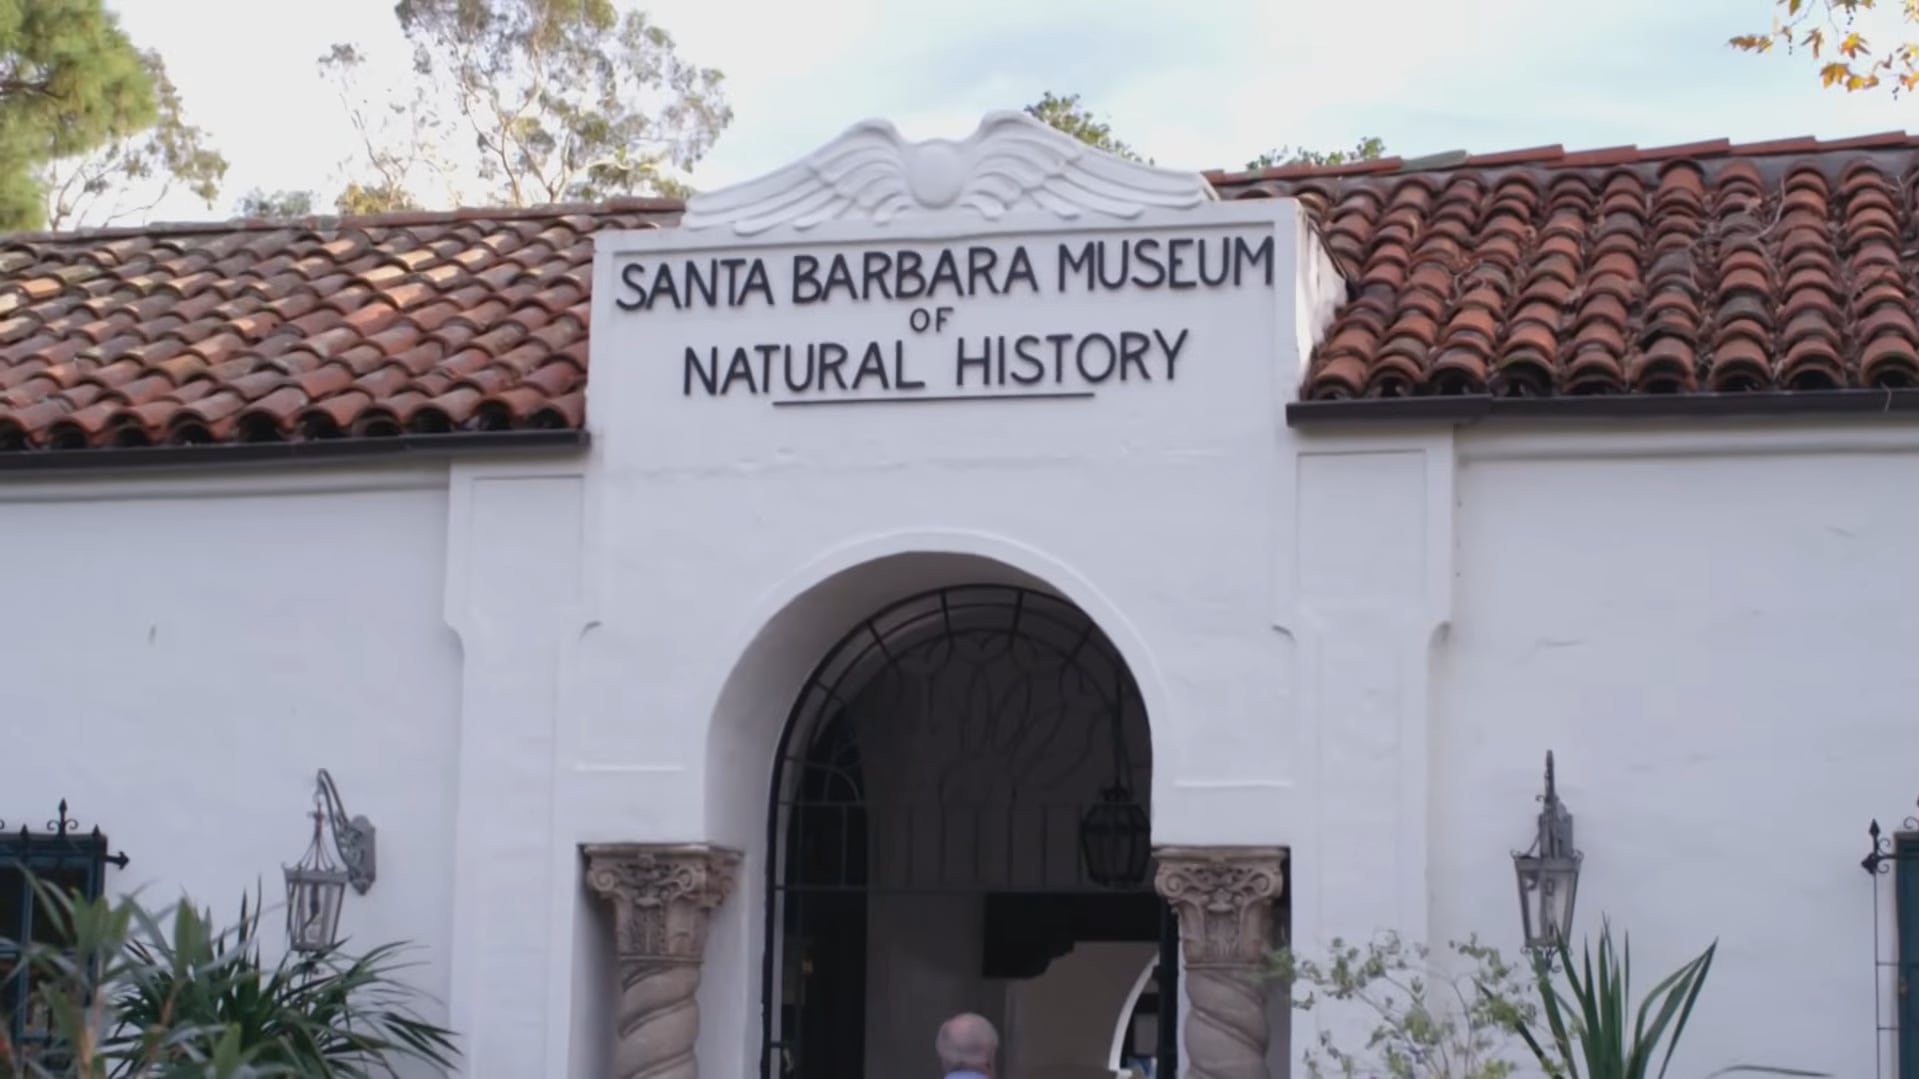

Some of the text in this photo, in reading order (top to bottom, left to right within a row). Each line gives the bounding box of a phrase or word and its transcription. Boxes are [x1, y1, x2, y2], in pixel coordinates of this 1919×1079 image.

[616, 236, 1274, 312] SANTA BARBARA MUSEUM
[909, 307, 954, 333] OF
[683, 329, 1188, 396] NATURAL HISTORY
